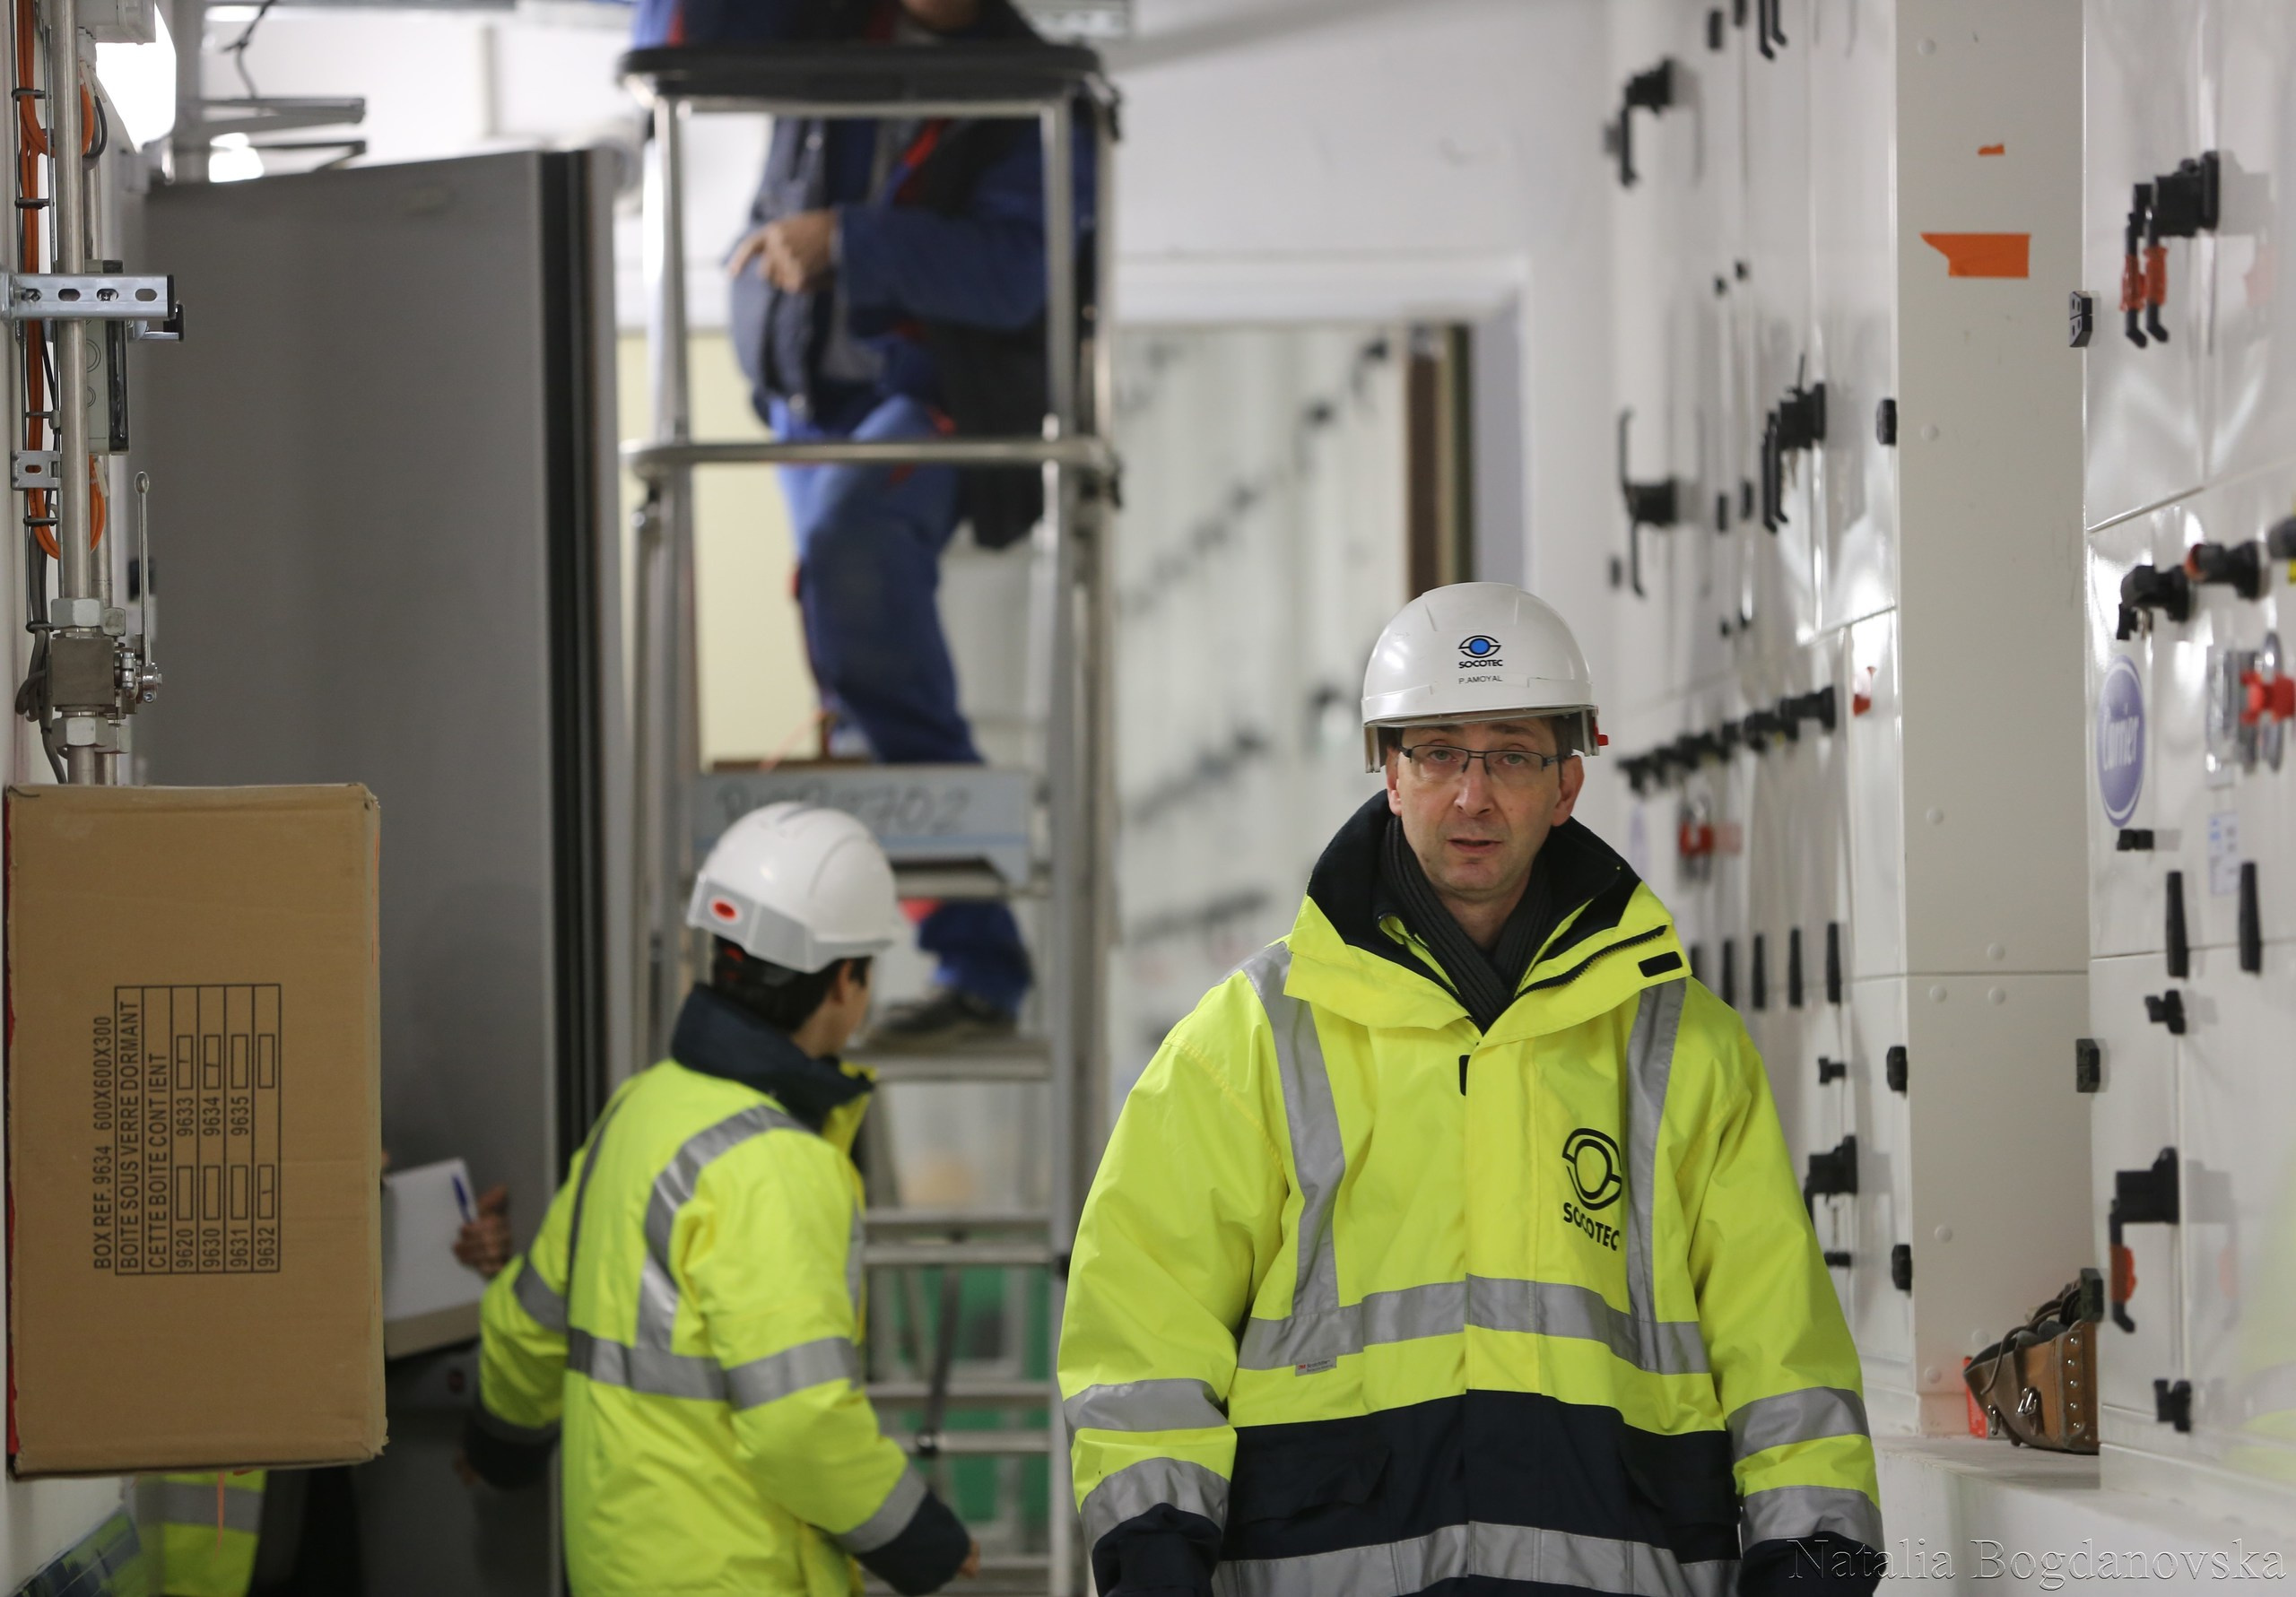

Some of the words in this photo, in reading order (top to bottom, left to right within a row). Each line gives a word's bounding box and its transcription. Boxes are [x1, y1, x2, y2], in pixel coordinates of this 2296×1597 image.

[1458, 659, 1503, 669] SOCOTEC
[120, 1001, 139, 1090] DORMANT
[93, 1016, 112, 1130] 600X600X300
[120, 1096, 139, 1156] VERRE
[176, 1097, 194, 1137] 9633
[203, 1096, 221, 1136] 9634
[230, 1096, 248, 1136] 9635
[92, 1145, 112, 1185] 9634
[149, 1152, 167, 1206] BOITE
[120, 1161, 139, 1210] SOUS
[93, 1189, 111, 1227] REF.
[1563, 1202, 1620, 1251] SOCOTEC
[93, 1231, 111, 1269] BOX
[120, 1215, 139, 1268] BOITE
[148, 1211, 167, 1269] CETTE
[176, 1228, 194, 1268] 9620
[203, 1228, 221, 1267] 9630
[230, 1228, 248, 1267] 9631
[257, 1227, 274, 1267] 9632
